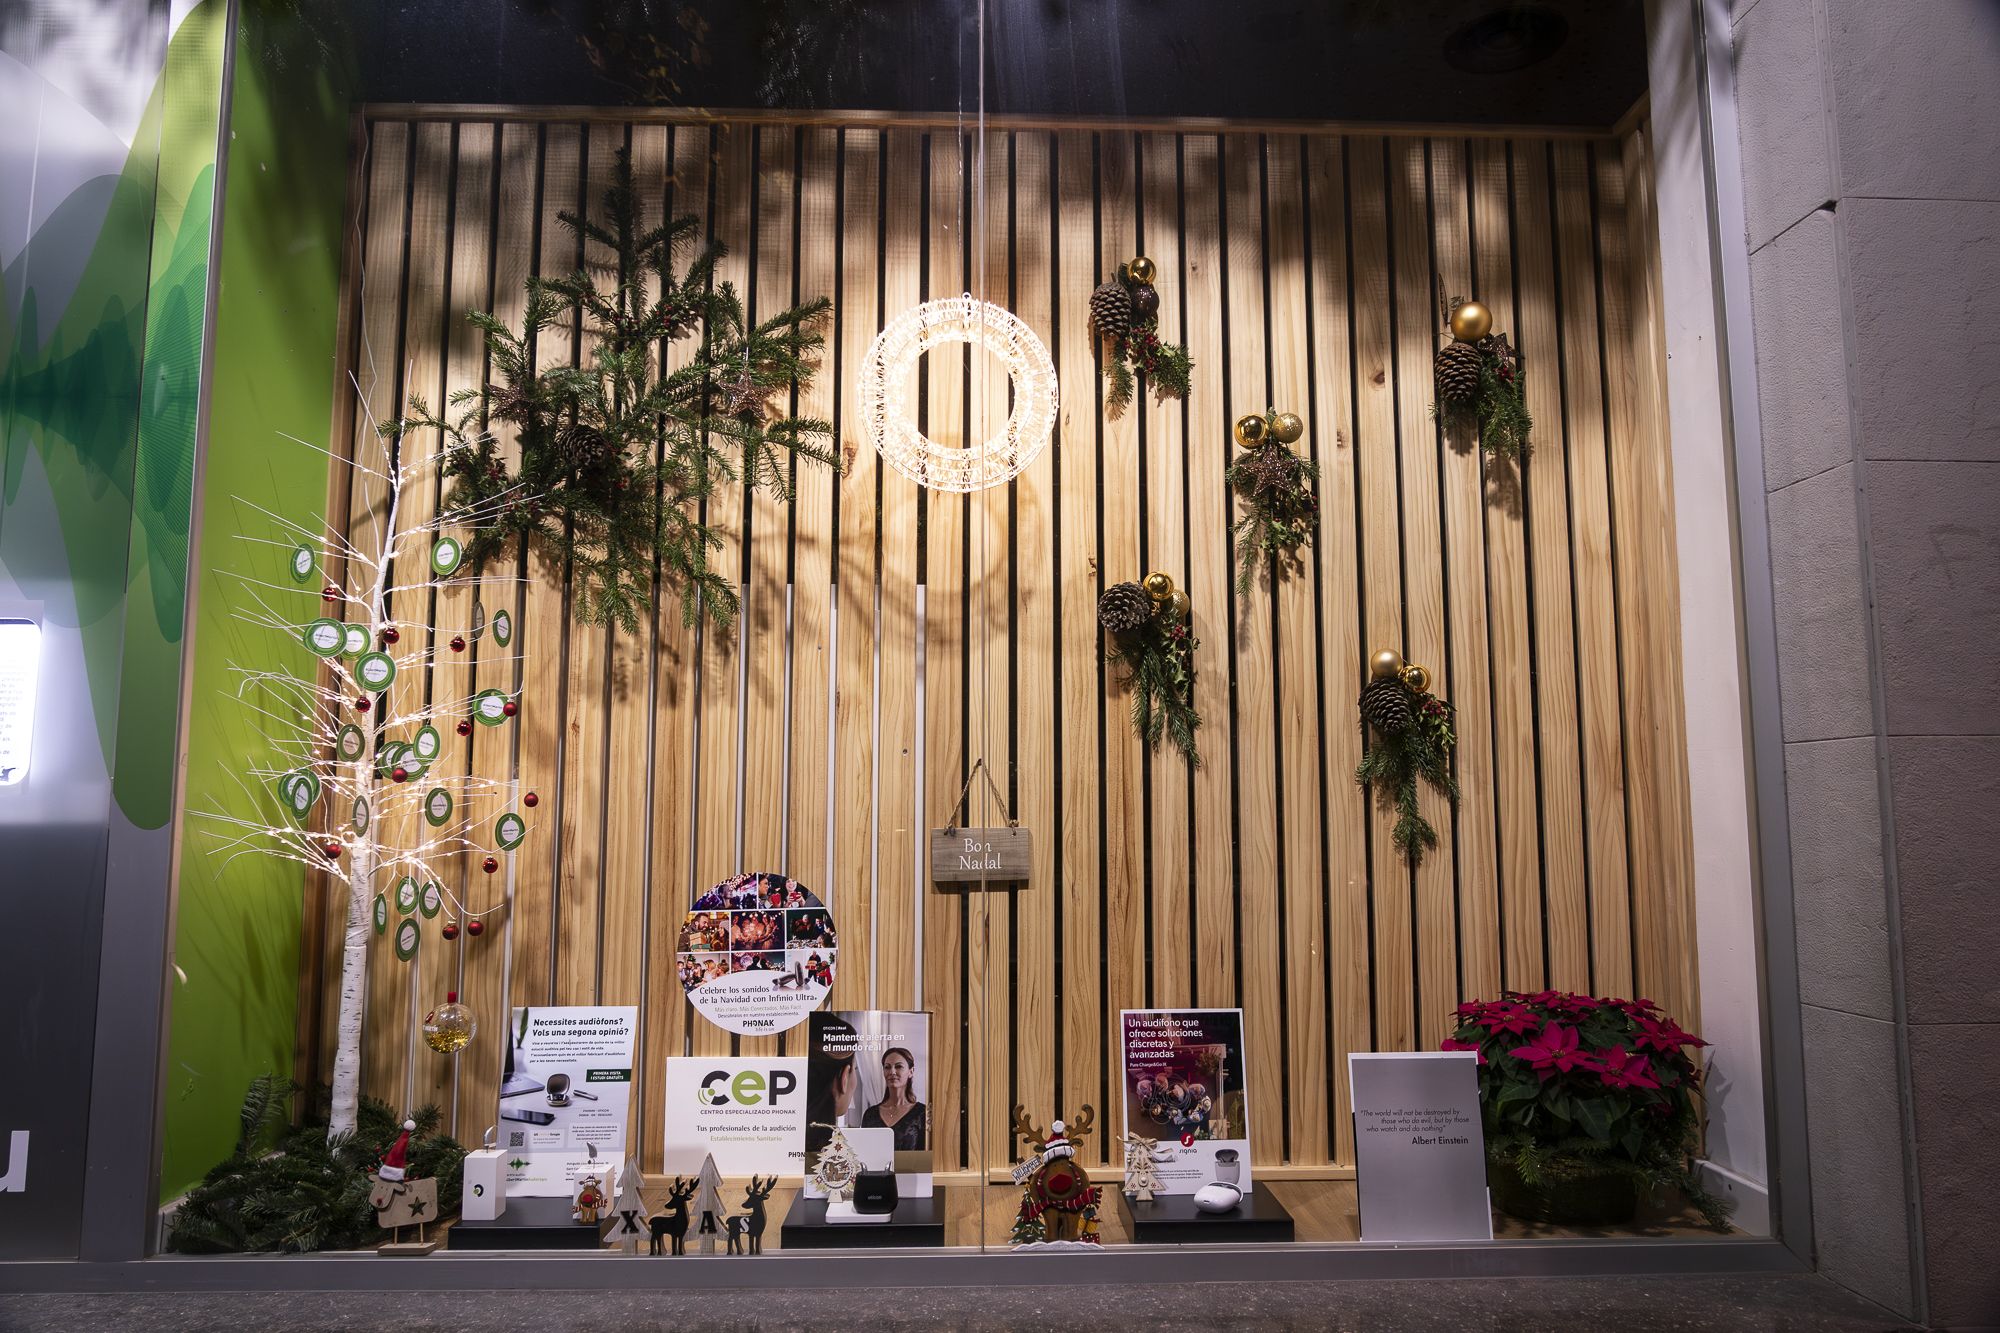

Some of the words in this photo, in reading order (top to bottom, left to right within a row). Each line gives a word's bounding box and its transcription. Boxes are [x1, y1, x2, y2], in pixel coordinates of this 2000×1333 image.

[700, 986, 726, 994] Celebre
[720, 995, 750, 1003] Navidad
[796, 992, 817, 1001] Ultra.
[1128, 1019, 1141, 1027] Un
[1142, 1018, 1181, 1027] audífono
[1183, 1020, 1199, 1029] que
[599, 1028, 628, 1036] opinió?
[1129, 1029, 1156, 1038] ofrece
[1158, 1028, 1203, 1037] soluciones
[1129, 1039, 1168, 1049] discretas
[1169, 1040, 1174, 1049] y
[1129, 1049, 1175, 1058] avanzadas
[1412, 1136, 1436, 1145] Albert
[1439, 1136, 1469, 1144] Einstein
[1179, 1148, 1198, 1156] signia
[621, 1210, 638, 1234] X
[699, 1210, 717, 1234] A
[739, 1217, 750, 1233] S
